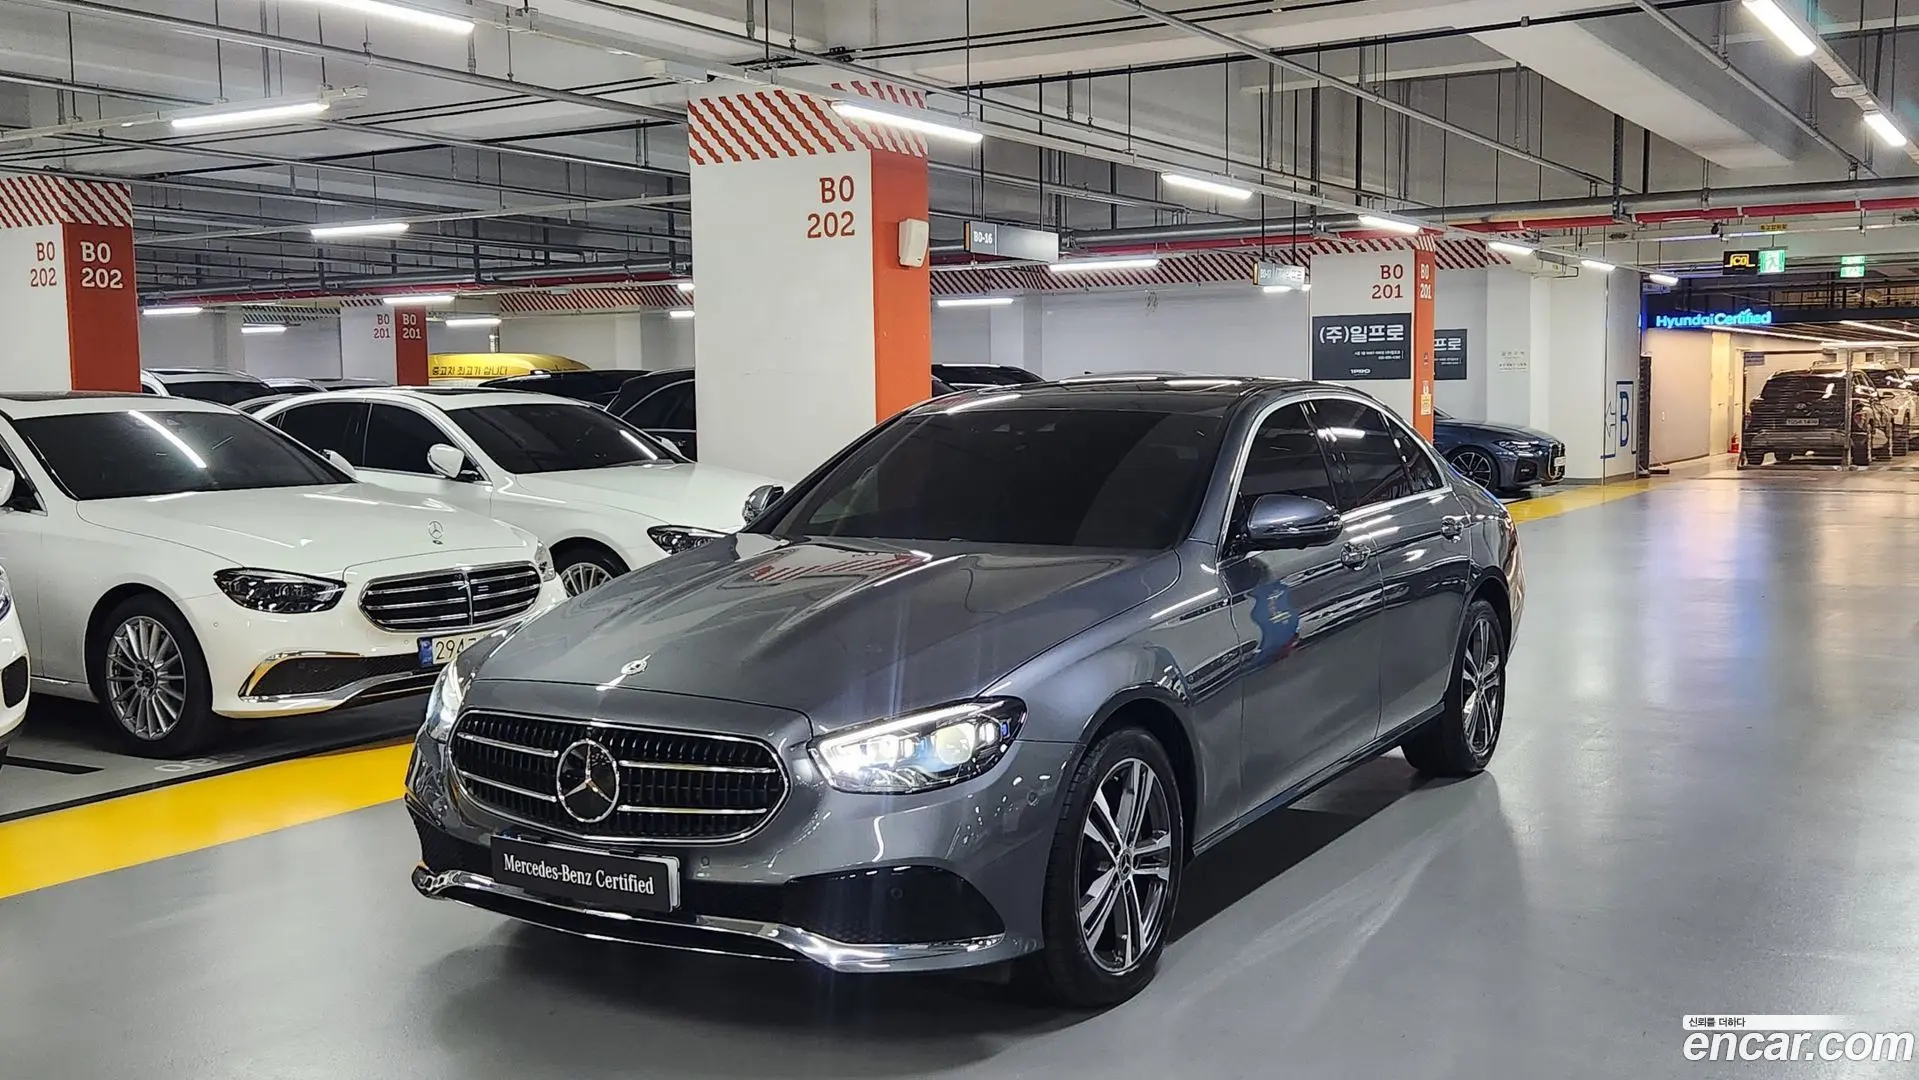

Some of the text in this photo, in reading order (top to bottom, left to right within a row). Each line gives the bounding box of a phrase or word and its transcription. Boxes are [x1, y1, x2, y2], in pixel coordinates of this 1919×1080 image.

[807, 210, 856, 239] 202
[30, 267, 57, 287] 202
[81, 267, 124, 289] 202
[1371, 284, 1404, 299] 201
[1419, 283, 1433, 300] 201
[1656, 308, 1772, 328] Hyundai Certified
[373, 327, 391, 339] 201
[402, 327, 422, 339] 201
[1319, 324, 1404, 344] (주)일프로
[1619, 391, 1629, 447] B
[436, 637, 477, 660] 294
[503, 853, 655, 895] Mercedes-Benz Certified
